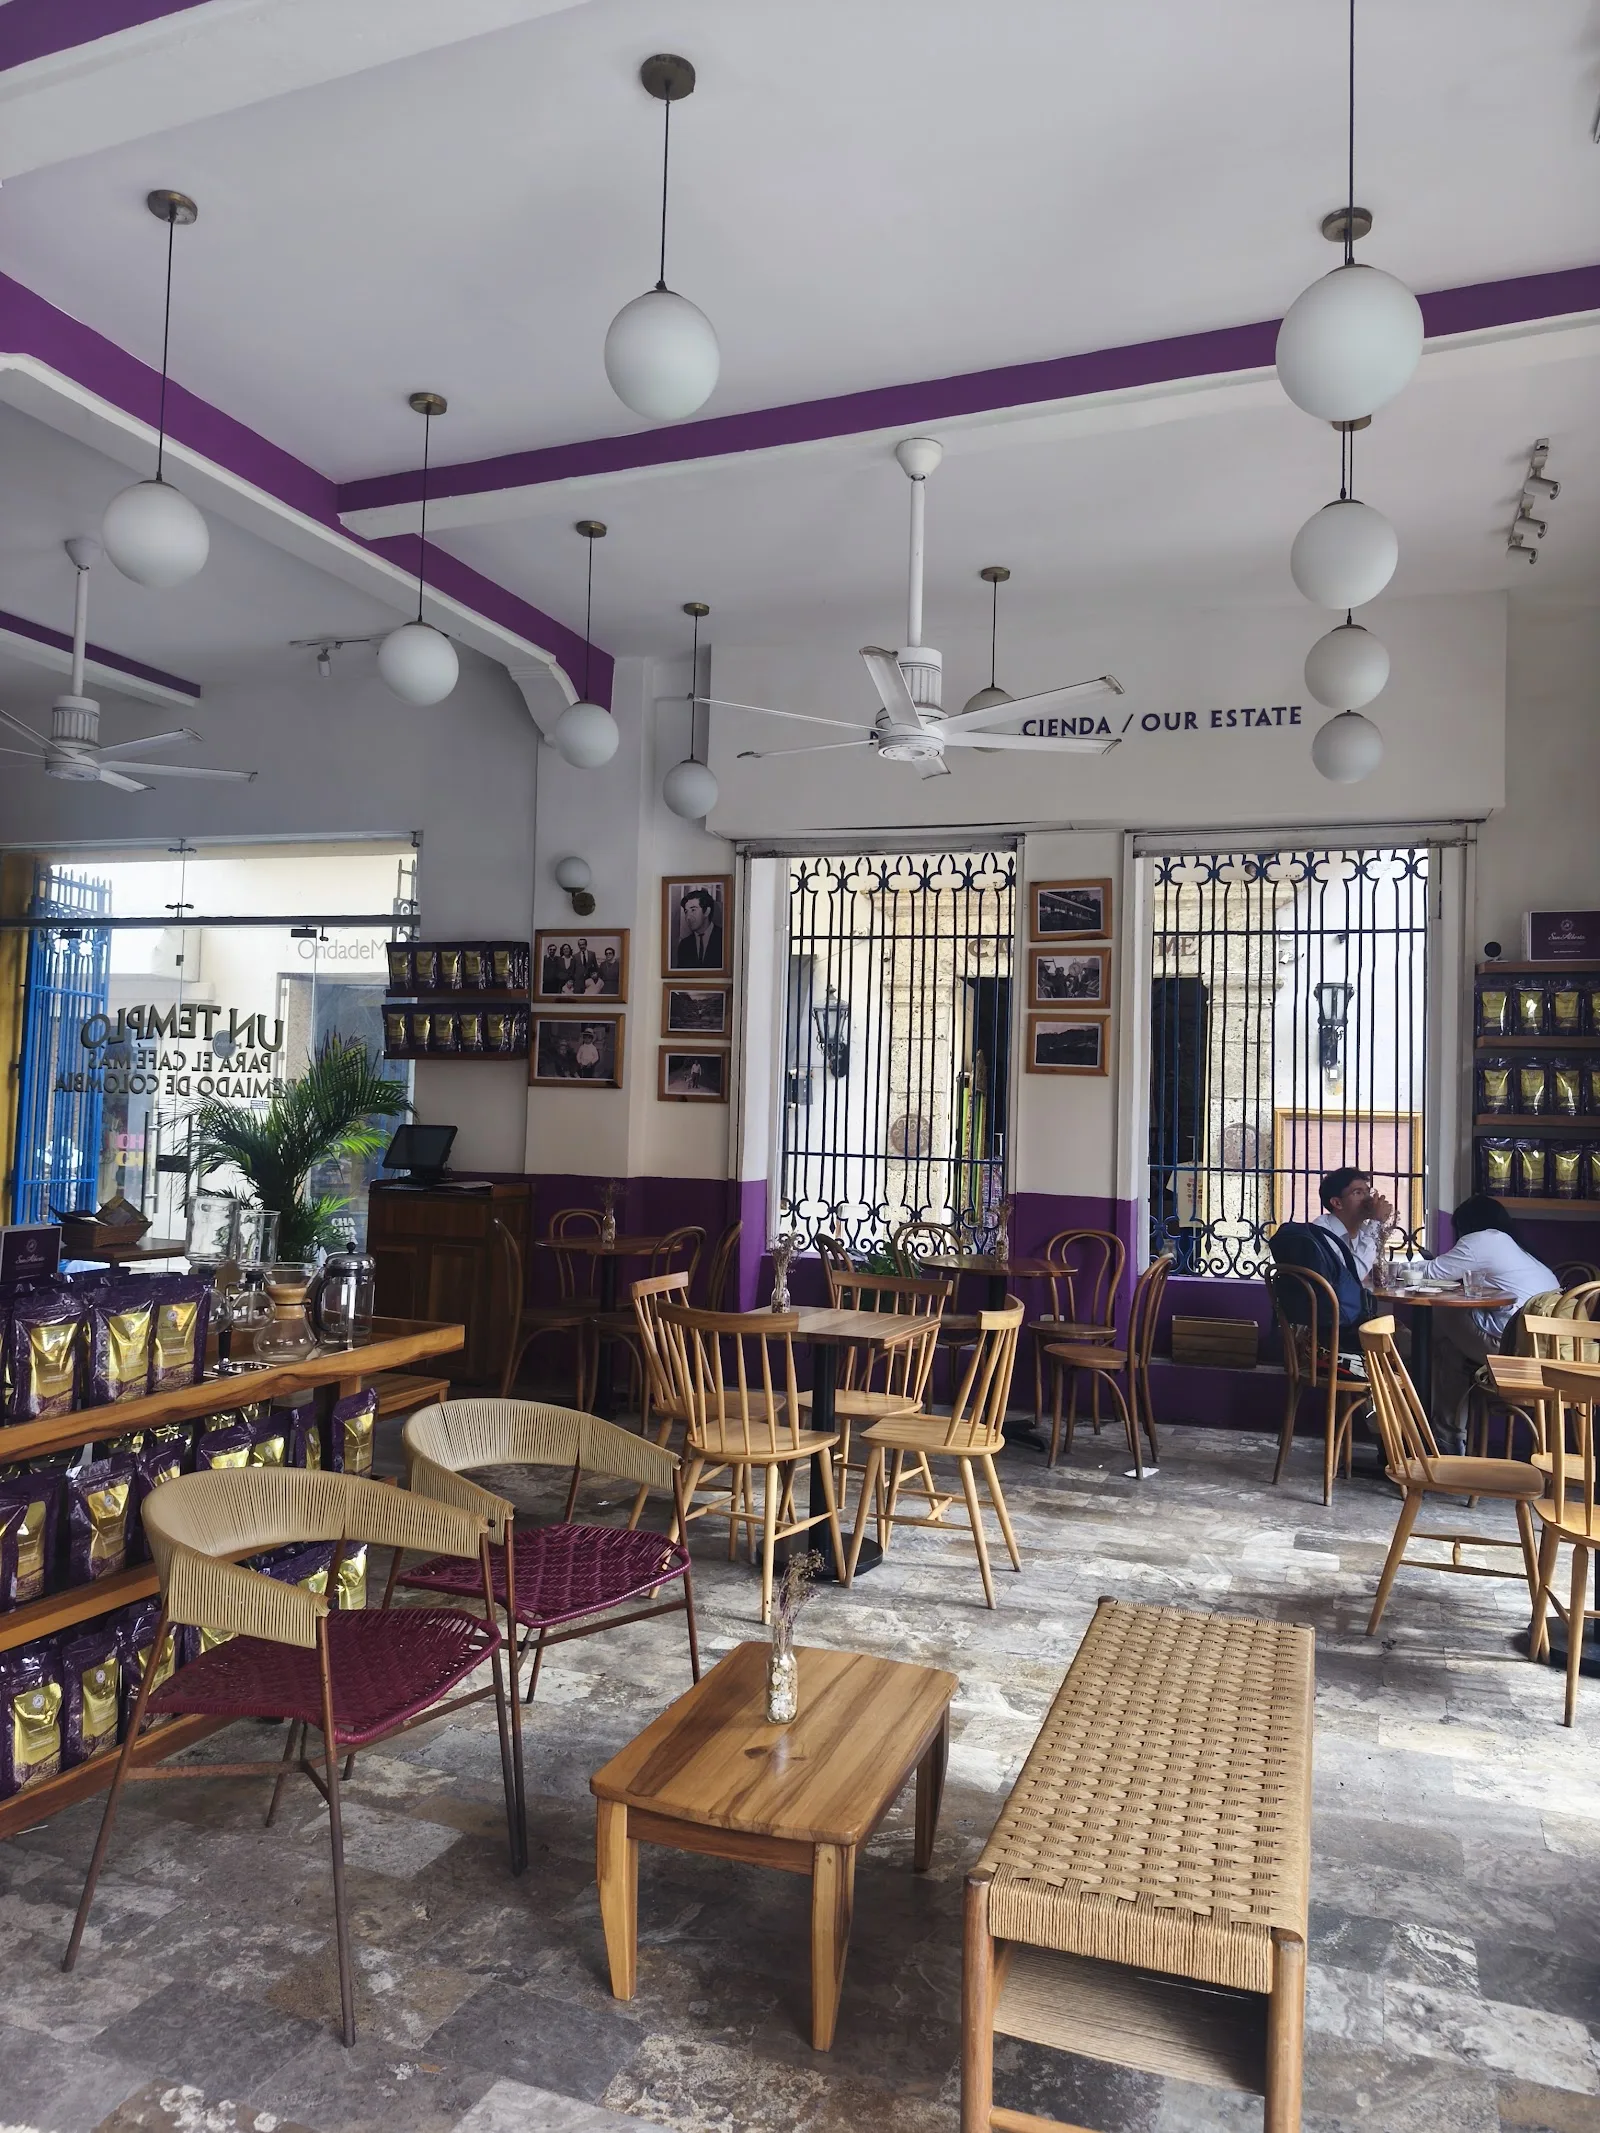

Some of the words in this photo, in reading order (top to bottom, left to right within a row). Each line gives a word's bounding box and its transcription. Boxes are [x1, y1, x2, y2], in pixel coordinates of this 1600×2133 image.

[1022, 716, 1112, 737] CIENDA
[1121, 713, 1134, 733] /
[1141, 711, 1199, 732] OUR
[1210, 706, 1303, 729] ESTATE
[331, 1217, 356, 1227] CHA
